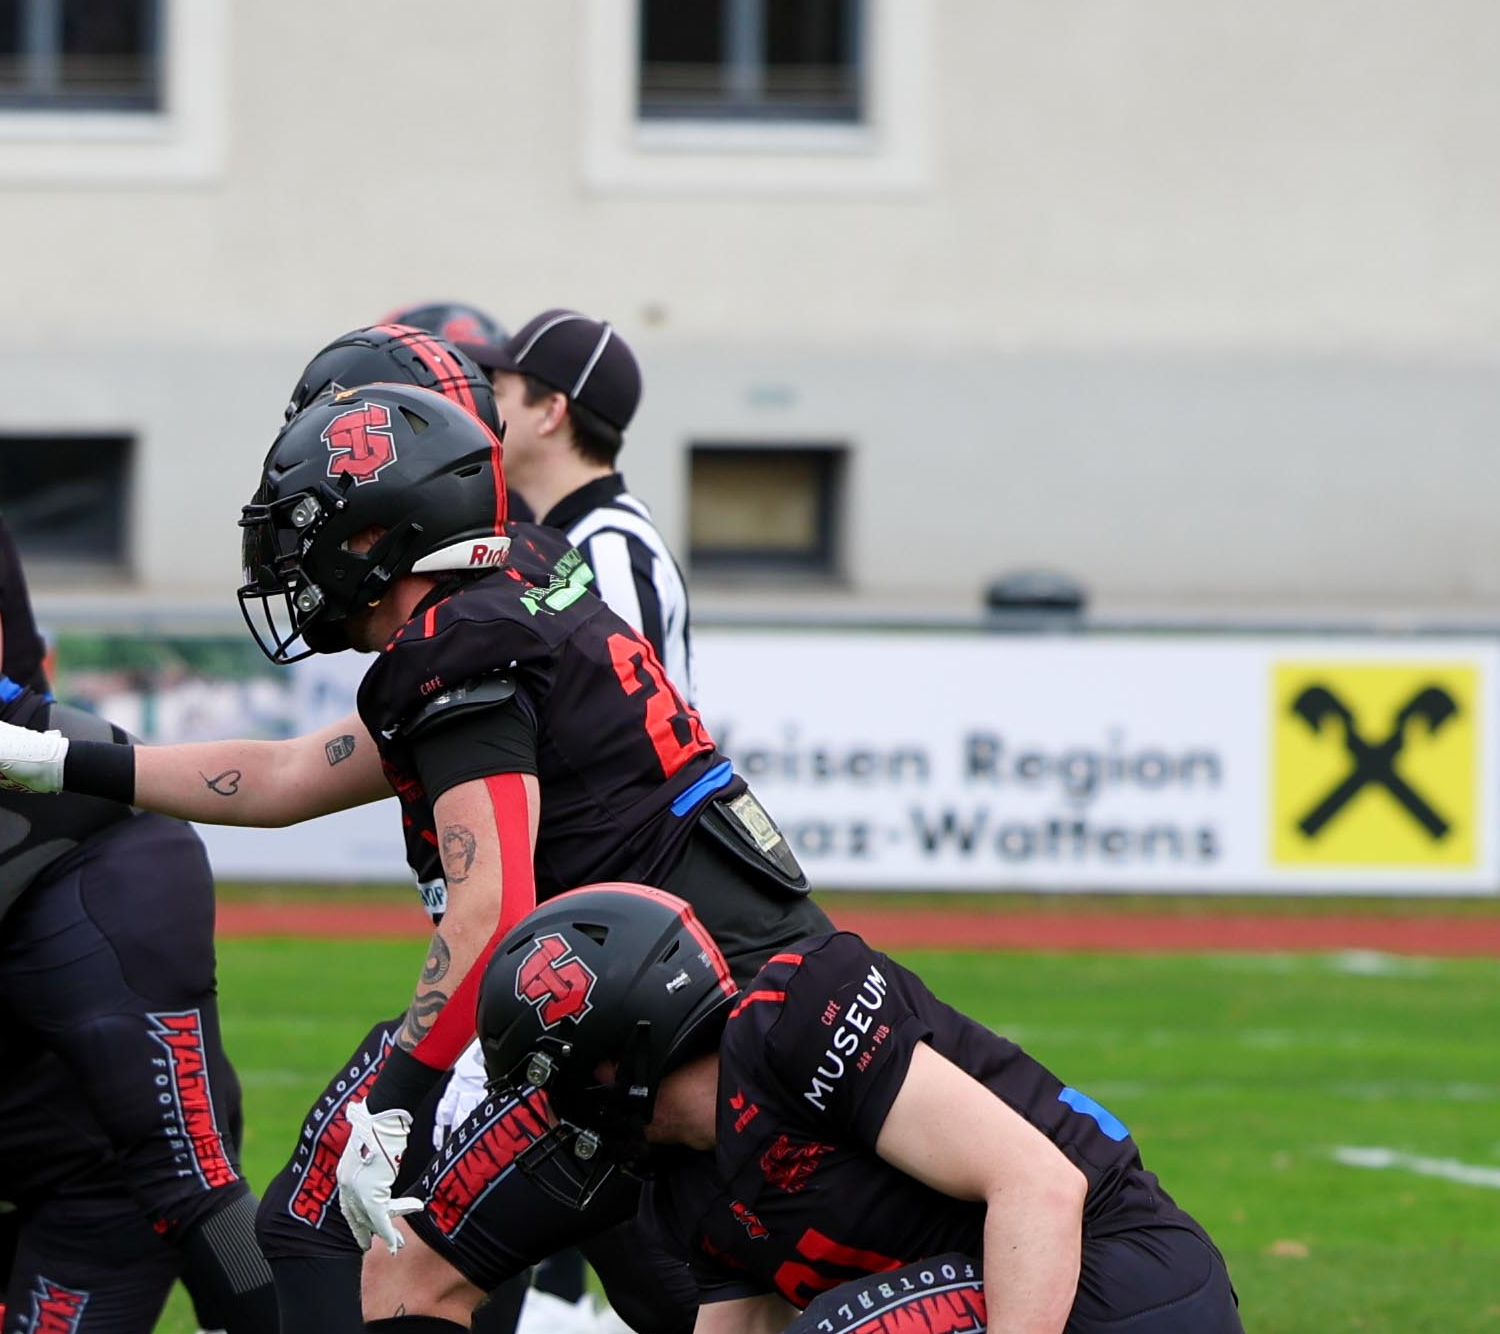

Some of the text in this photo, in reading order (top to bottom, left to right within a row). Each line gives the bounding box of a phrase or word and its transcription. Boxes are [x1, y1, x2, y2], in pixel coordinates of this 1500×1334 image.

[963, 731, 1220, 793] Region
[803, 964, 888, 1111] MUSEUM
[821, 999, 842, 1027] CAFÉ
[856, 1024, 891, 1073] BAR PUB
